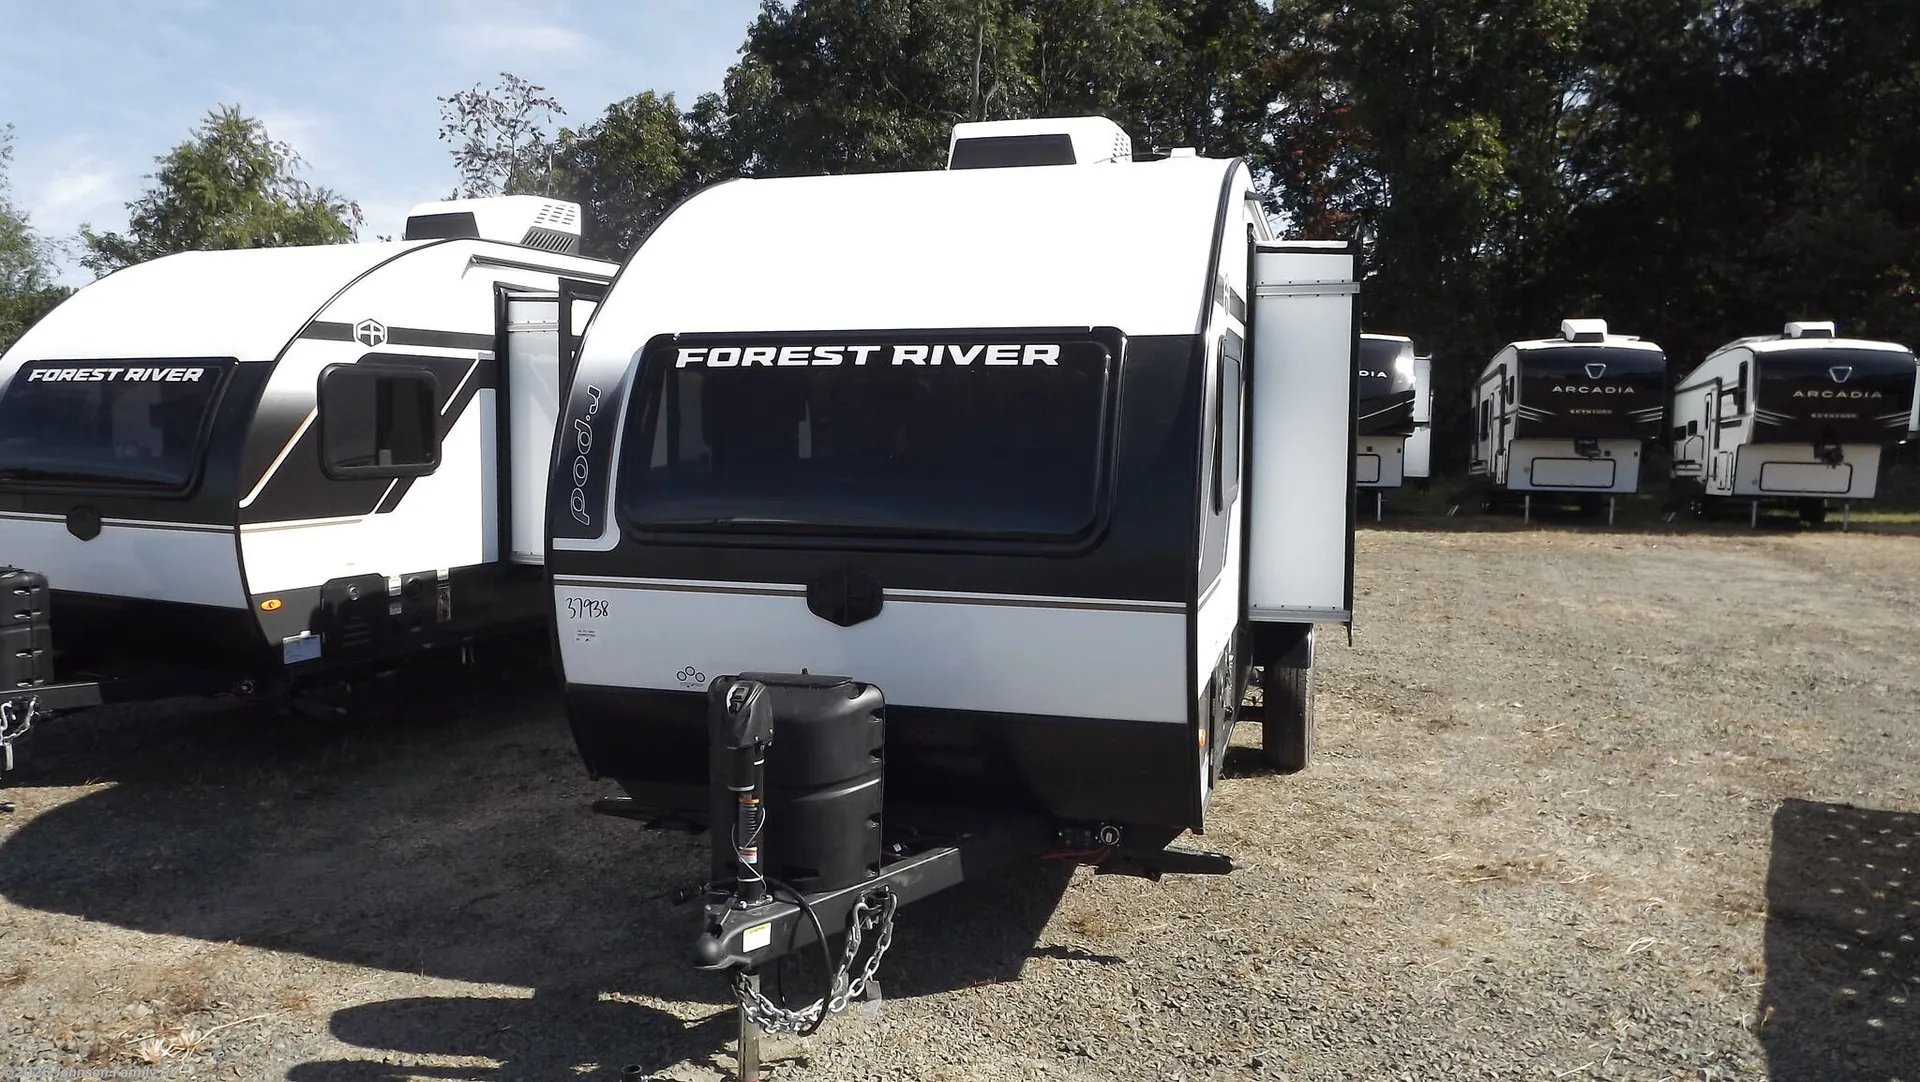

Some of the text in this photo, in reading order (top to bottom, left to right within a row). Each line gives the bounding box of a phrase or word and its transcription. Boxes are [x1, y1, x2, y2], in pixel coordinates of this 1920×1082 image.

[675, 344, 1060, 368] FOREST RIVER
[27, 367, 205, 382] FOREST RIVER
[1552, 385, 1635, 394] ARCADIA
[1792, 390, 1882, 399] ARCADIA
[565, 597, 609, 619] 37938
